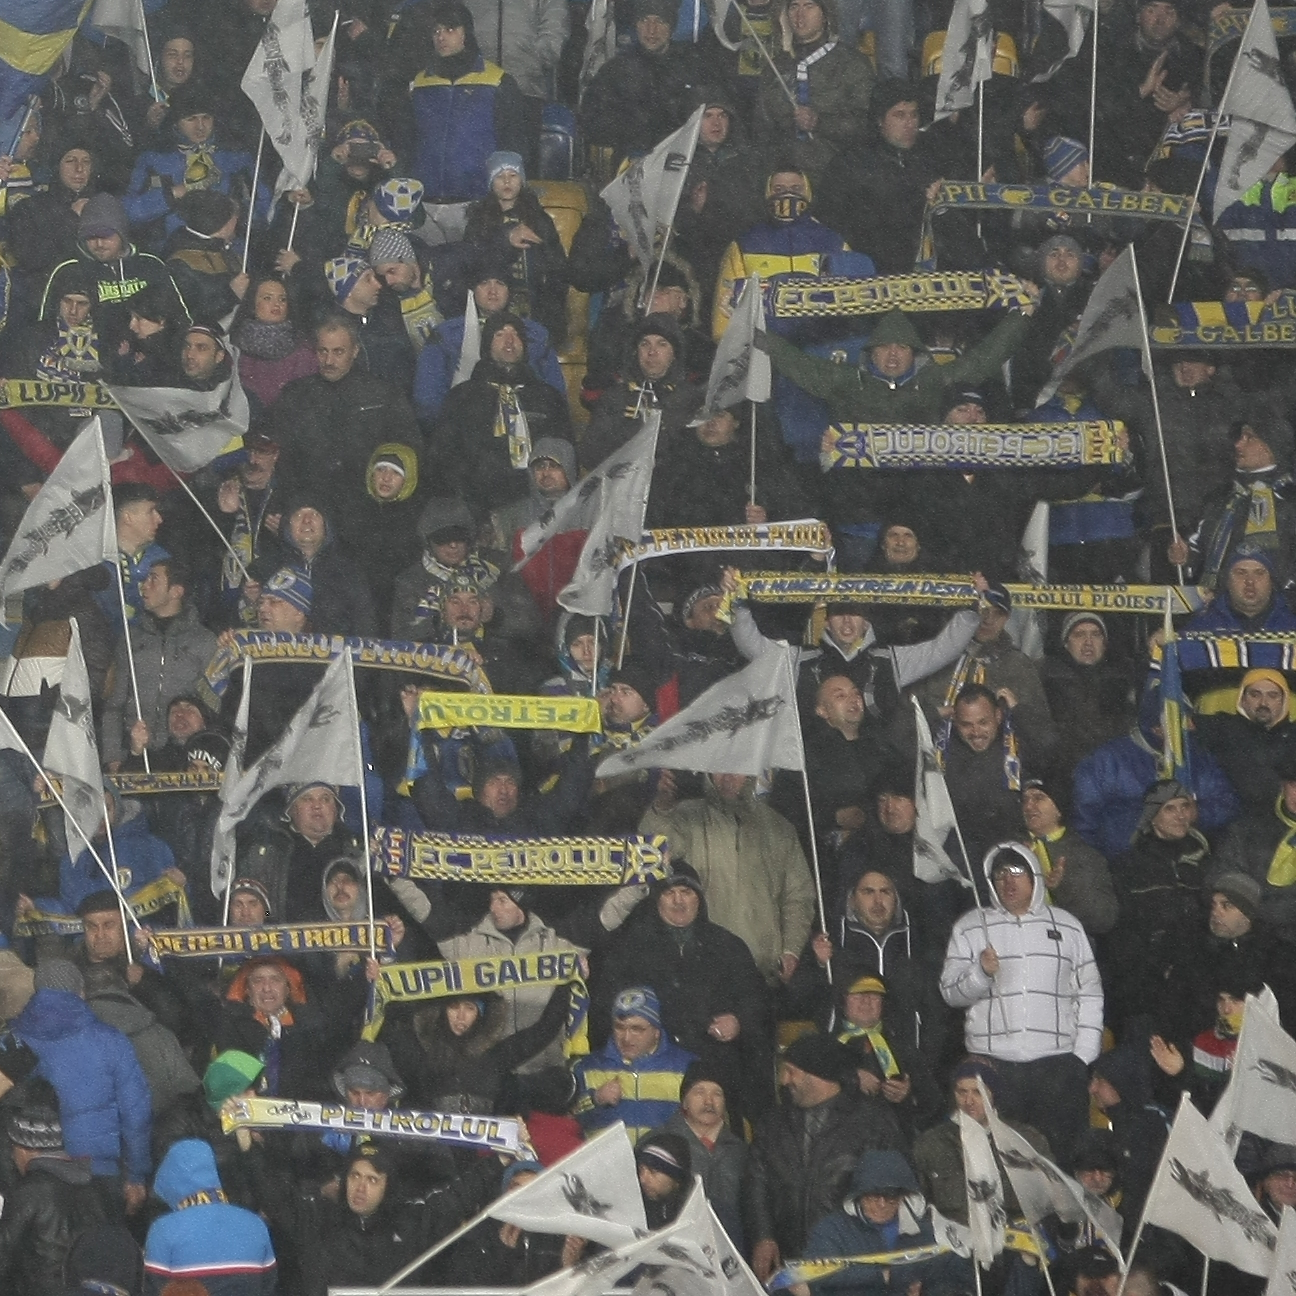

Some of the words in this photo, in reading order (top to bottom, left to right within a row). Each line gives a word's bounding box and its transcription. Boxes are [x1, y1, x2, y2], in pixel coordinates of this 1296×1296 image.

[837, 277, 984, 307] PETROLUL
[187, 750, 223, 773] NINE
[470, 846, 623, 873] PETROLUL
[320, 1105, 508, 1146] PETROLUL
